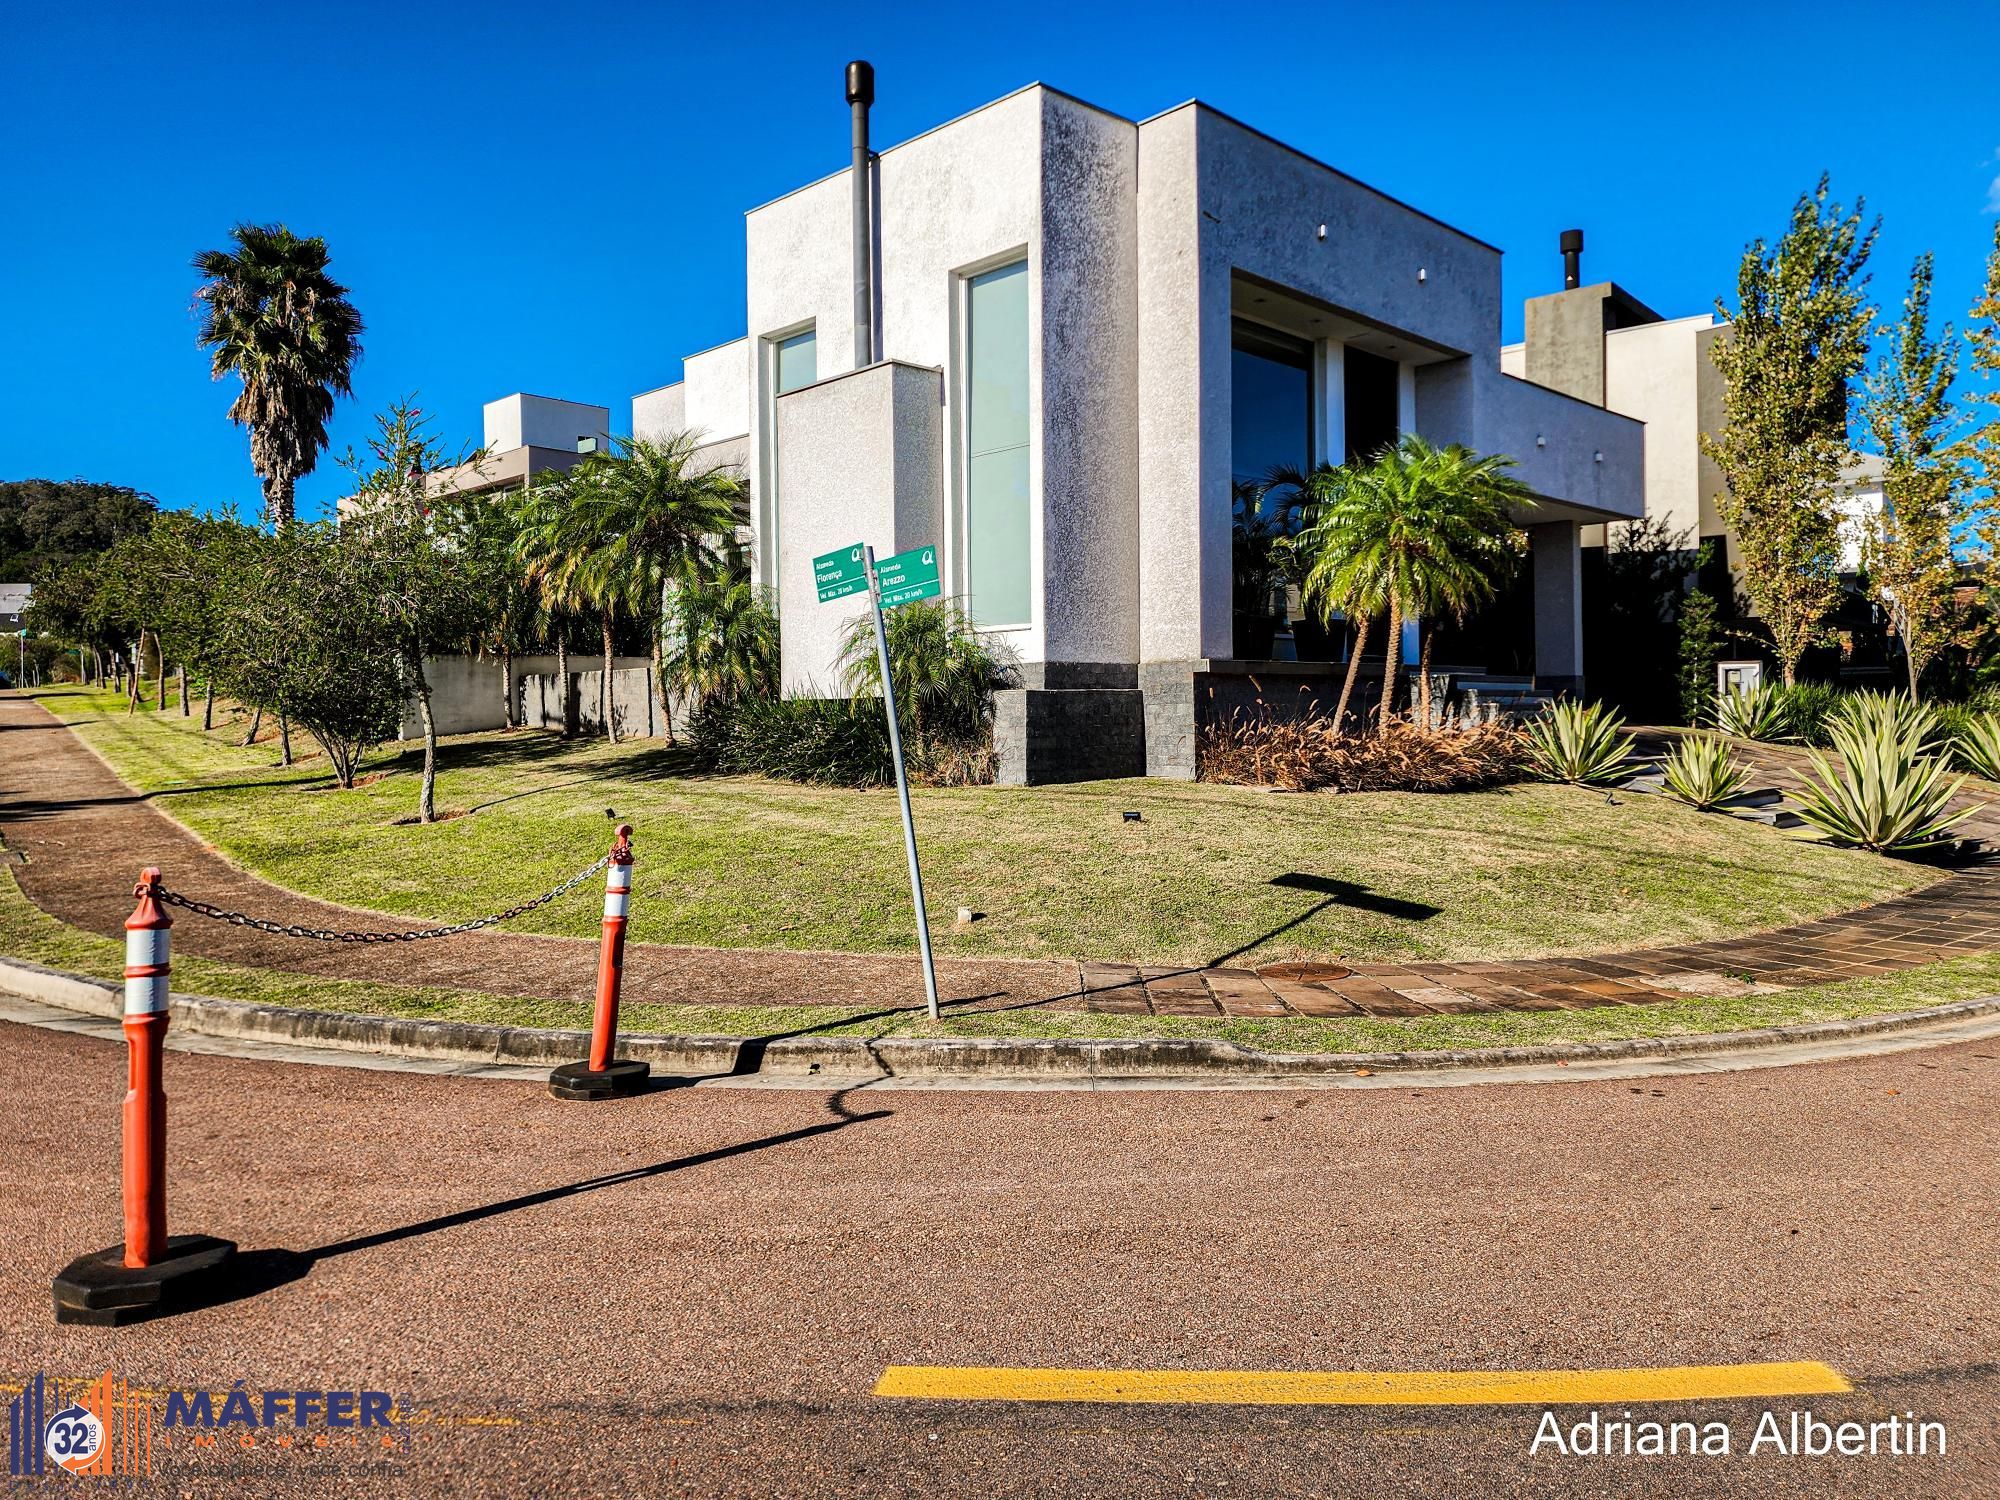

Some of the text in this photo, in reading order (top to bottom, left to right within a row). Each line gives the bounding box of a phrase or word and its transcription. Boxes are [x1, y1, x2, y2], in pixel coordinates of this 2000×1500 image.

[880, 563, 902, 574] Alameda
[817, 570, 843, 583] Florença
[882, 575, 906, 587] Arezzo
